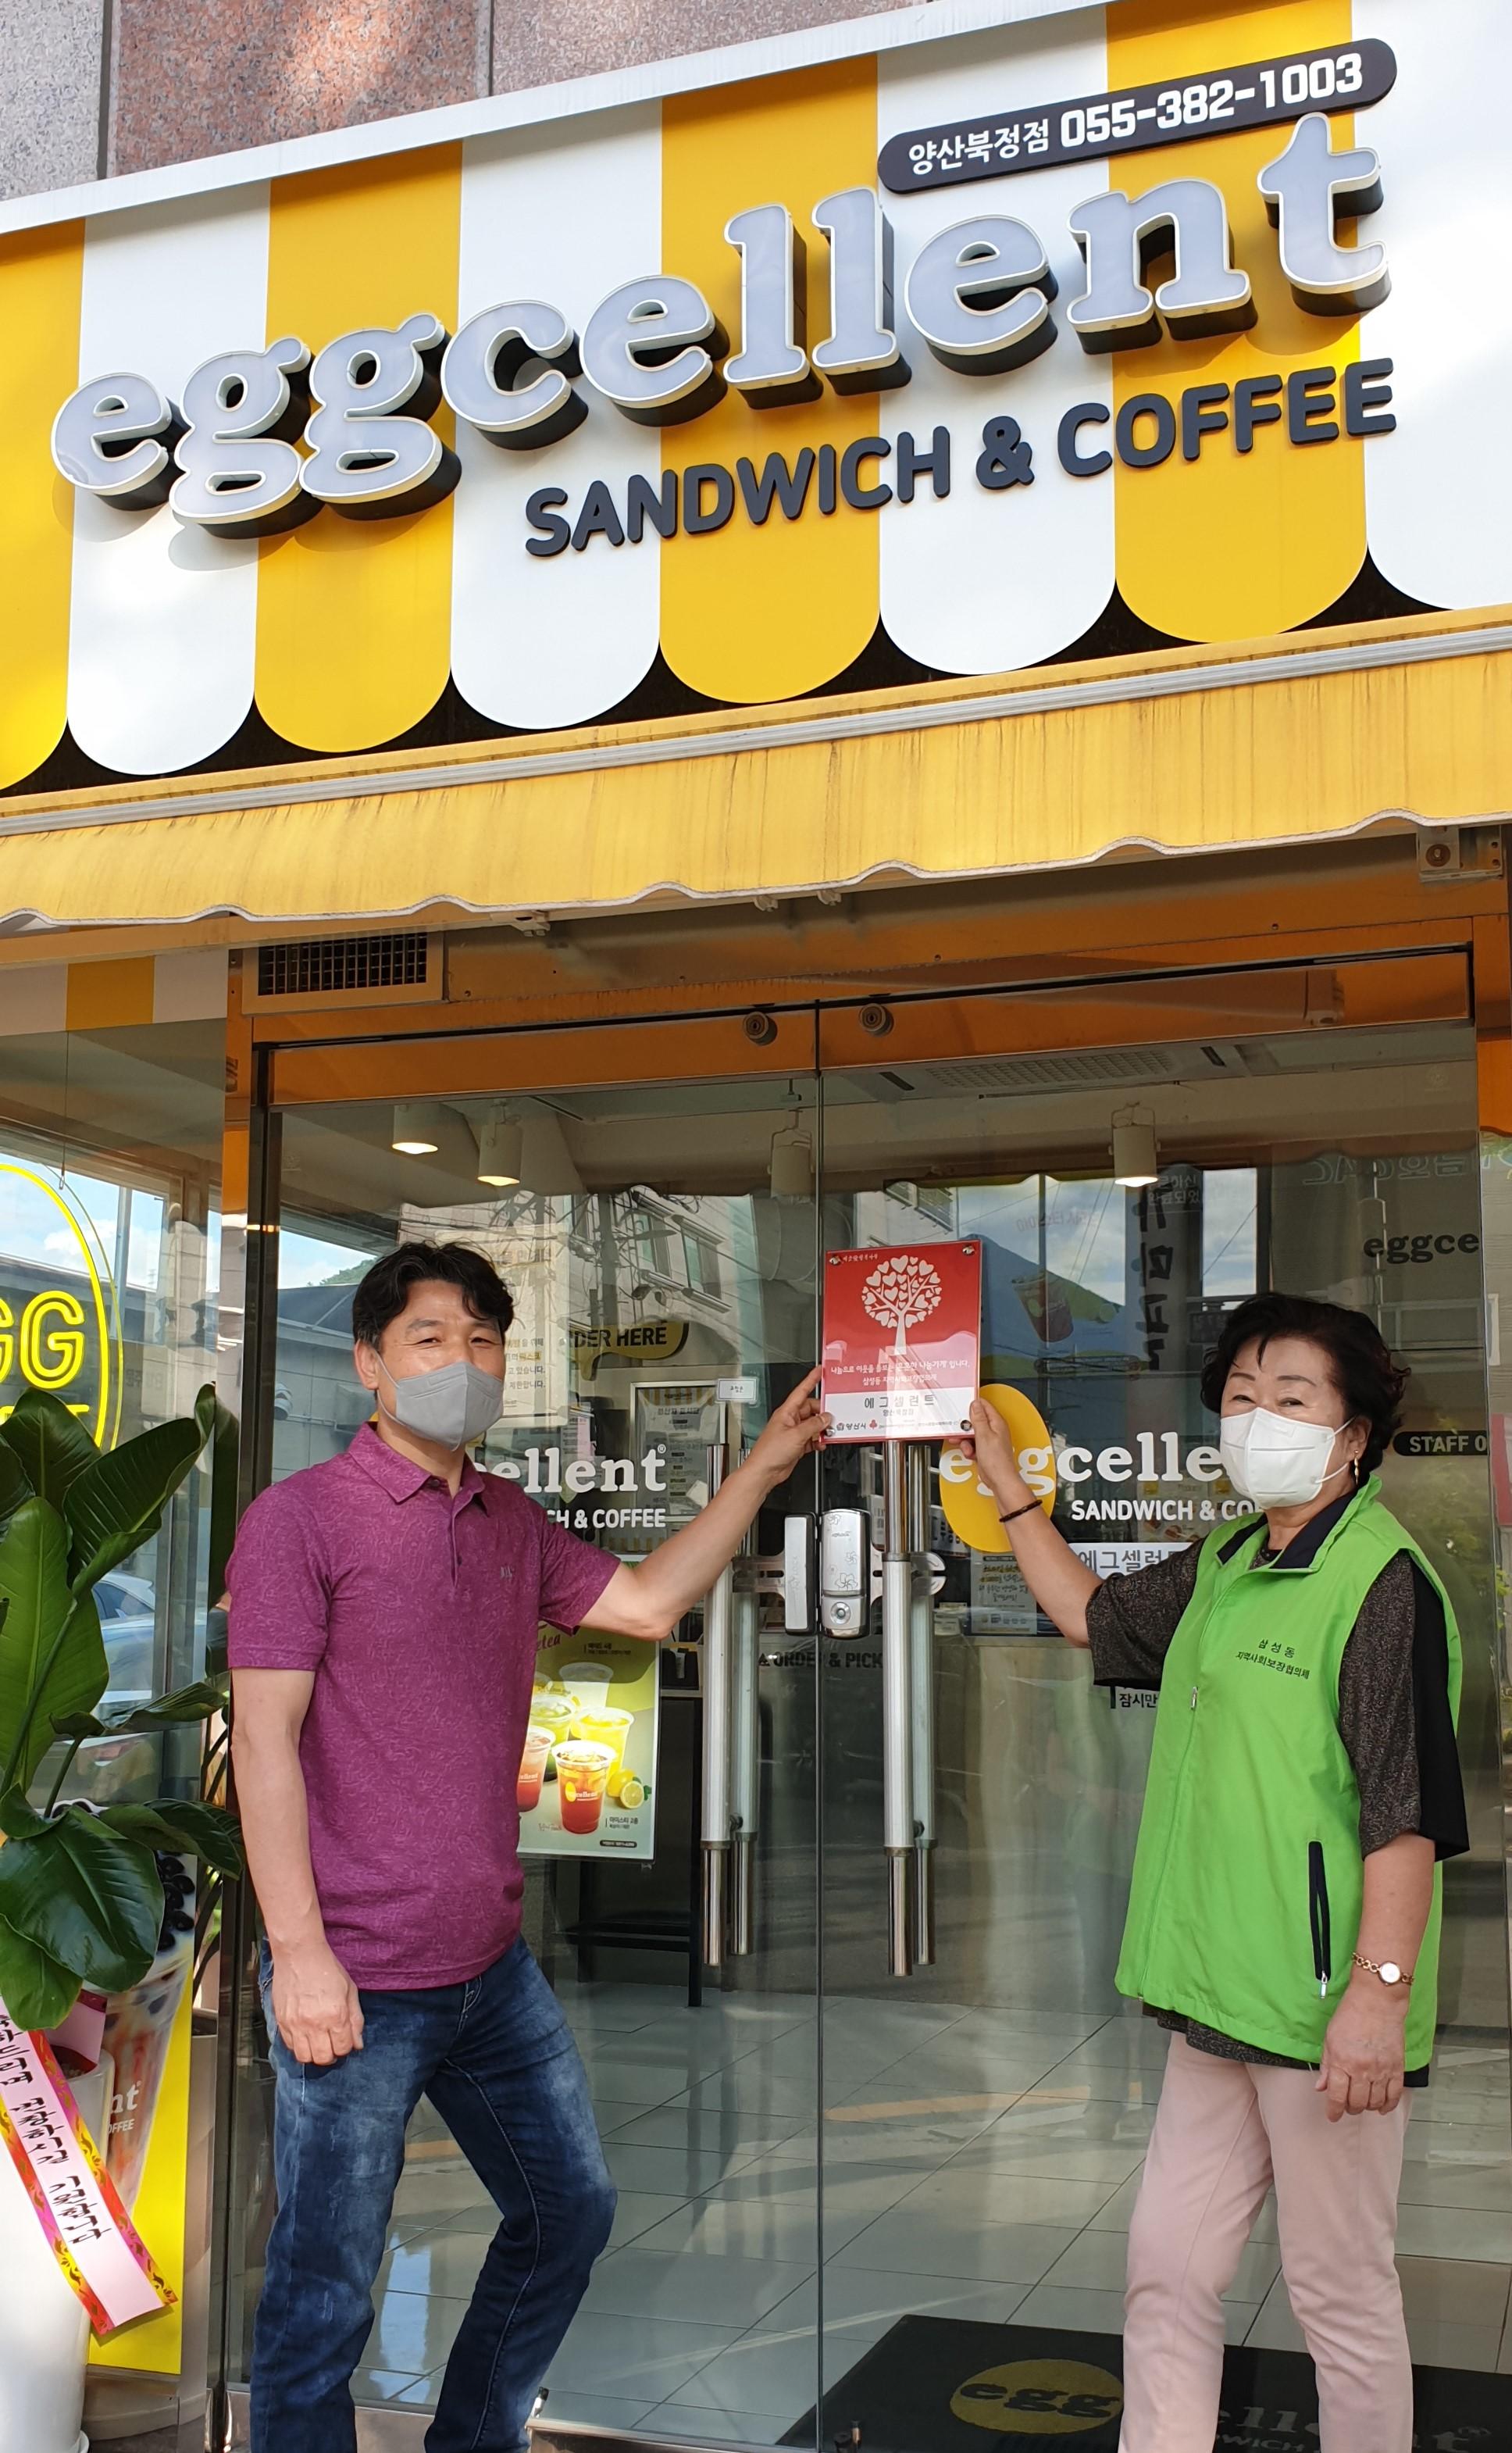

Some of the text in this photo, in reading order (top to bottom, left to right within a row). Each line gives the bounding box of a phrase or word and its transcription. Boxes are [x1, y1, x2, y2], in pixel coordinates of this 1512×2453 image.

[908, 52, 1363, 176] 양산북정점 055-382-1003
[51, 112, 1392, 535] eggcellent
[525, 358, 1396, 558] SANDWICH & COFFEE
[0, 1290, 85, 1390] G
[569, 1326, 668, 1348] DER HERE
[1410, 1436, 1469, 1453] STAFF
[473, 1447, 667, 1494] ellent
[574, 1509, 588, 1529] &
[592, 1509, 666, 1529] COFFEE
[1071, 1500, 1194, 1522] SANDWICH
[1199, 1500, 1216, 1521] &
[773, 1651, 824, 1668] ORDE
[1235, 1651, 1311, 1680] 지역사회보장협의체
[1118, 1693, 1158, 1709] 잠시만
[10, 2097, 70, 2166] 번창하시길
[48, 2175, 112, 2245] 기원합니다
